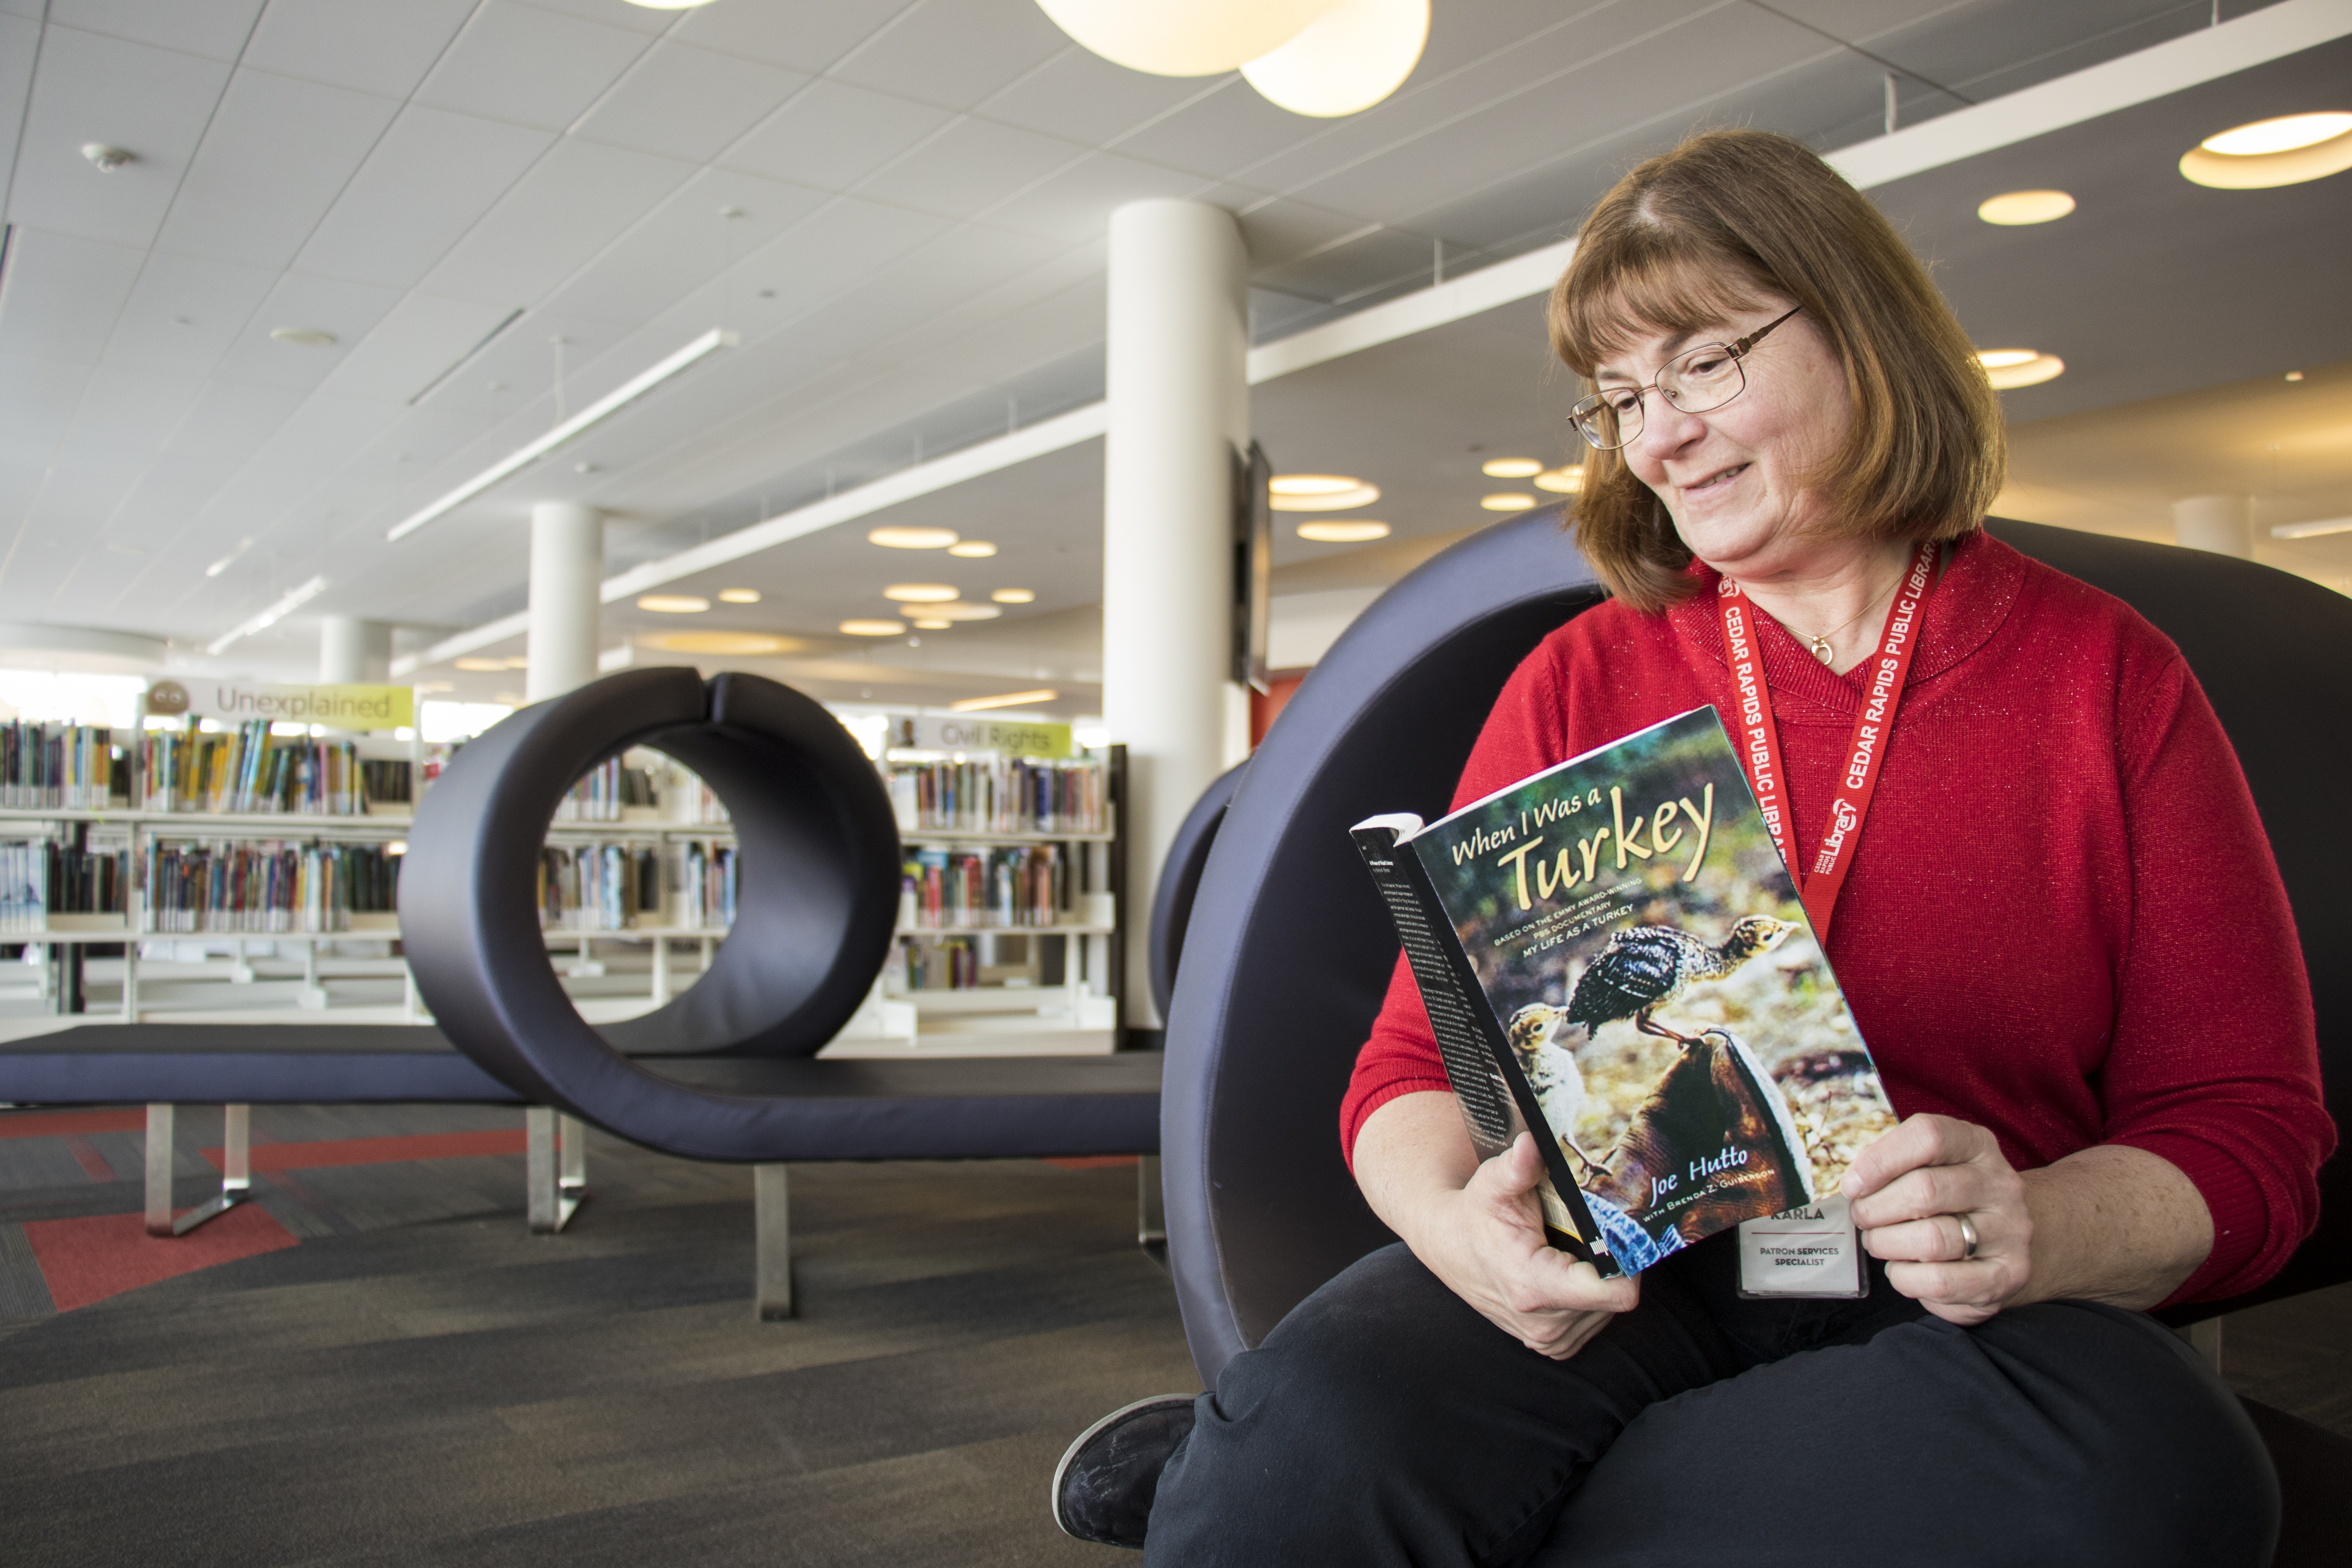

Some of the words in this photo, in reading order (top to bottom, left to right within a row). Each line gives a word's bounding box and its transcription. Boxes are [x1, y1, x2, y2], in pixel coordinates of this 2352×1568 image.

[1725, 607, 1749, 661] CEDAR
[217, 686, 391, 719] Unexplained
[1736, 662, 1762, 726] RAPIDS
[1846, 726, 1879, 789] CEDAR
[1865, 658, 1898, 722] RAPIDS
[1885, 600, 1916, 655] PUBLIC
[940, 722, 980, 745] Civil
[989, 726, 1051, 752] Rights
[1748, 728, 1774, 792] PUBLIC
[1452, 827, 1516, 866] When
[1522, 812, 1528, 835] I
[1534, 798, 1582, 828] Was
[1587, 787, 1602, 806] a
[1498, 782, 1713, 910] Turkey
[1821, 802, 1856, 856] Library
[1814, 854, 1825, 873] CEDAR
[1819, 856, 1831, 873] RAPIDS
[1825, 857, 1836, 875] PUBLIC
[1494, 929, 1521, 946] BASED
[1522, 923, 1535, 932] ON
[1535, 916, 1553, 927] THE
[1553, 904, 1576, 919] EMMY
[1577, 878, 1642, 908] AWARD-WINNING
[1523, 944, 1538, 958] MY
[1540, 934, 1564, 950] LIFE
[1566, 927, 1580, 940] AS
[1582, 923, 1590, 931] A
[1591, 903, 1633, 926] TURKEY
[1533, 928, 1551, 940] PBS
[1552, 901, 1611, 932] DOCUMENTARY
[1650, 1174, 1678, 1208] Joe
[1689, 1145, 1748, 1181] Hutto
[1706, 1184, 1718, 1193] Z.
